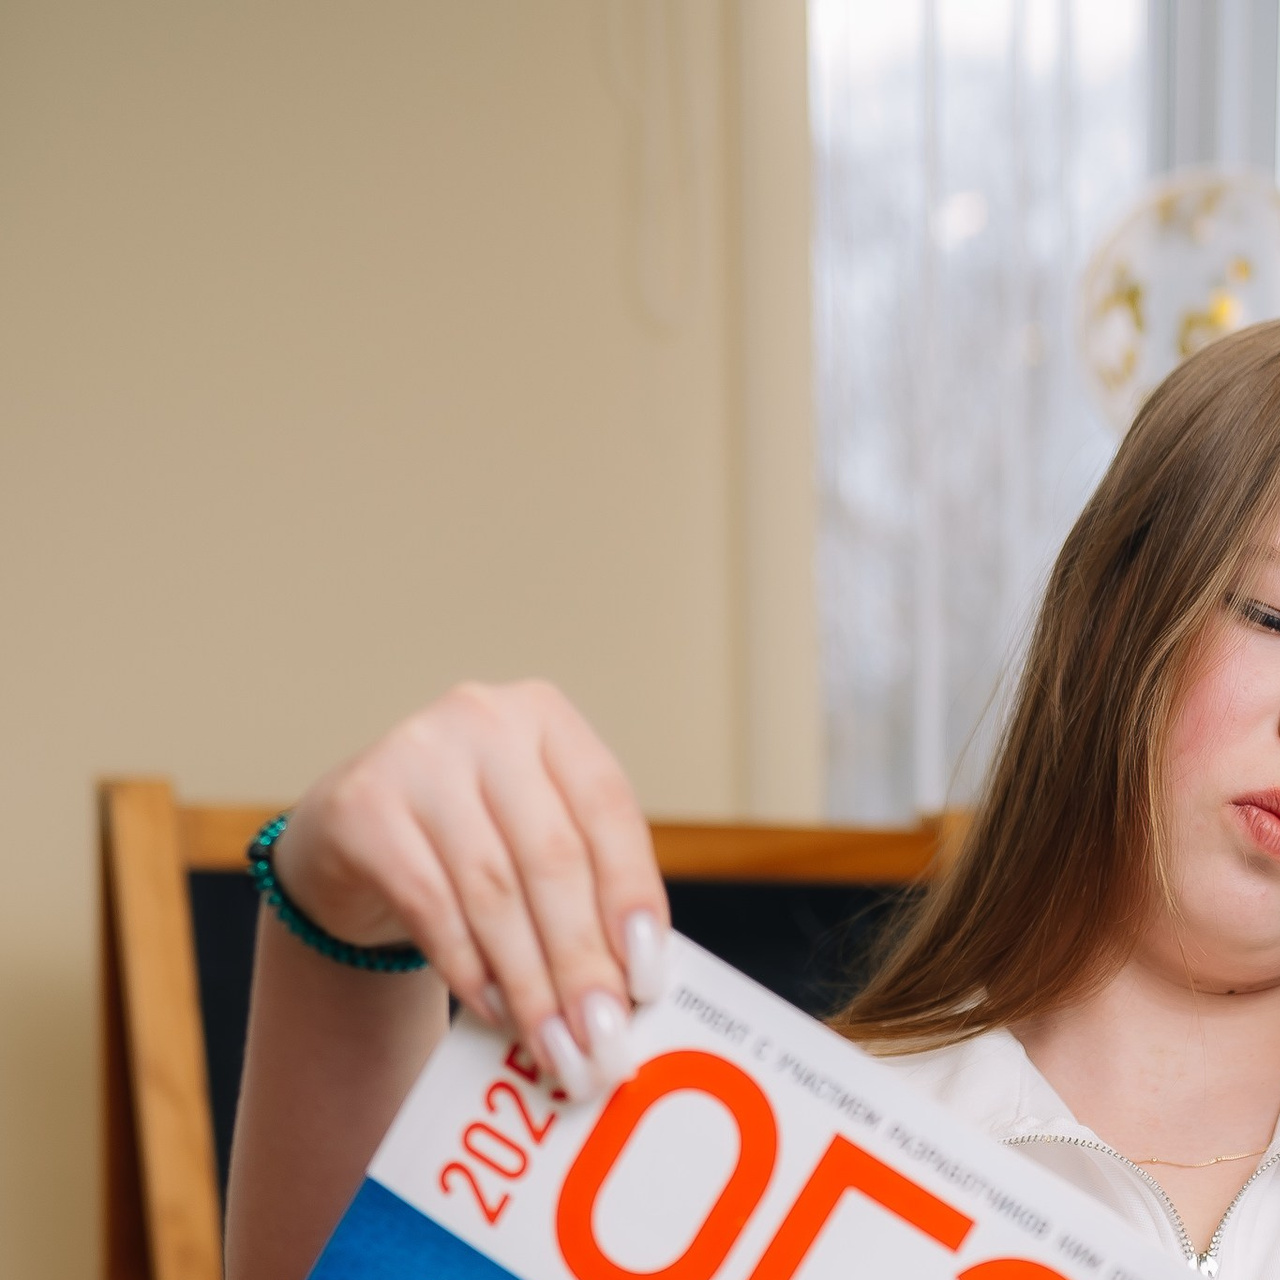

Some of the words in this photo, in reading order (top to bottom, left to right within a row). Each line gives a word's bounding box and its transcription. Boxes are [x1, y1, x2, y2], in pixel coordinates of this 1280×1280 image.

[672, 985, 752, 1044] ПРОЕКТ
[749, 1035, 774, 1062] С
[775, 1051, 884, 1130] УЧАСТИЕМ
[886, 1121, 1052, 1238] РАЗРАБОТЧИКОВ
